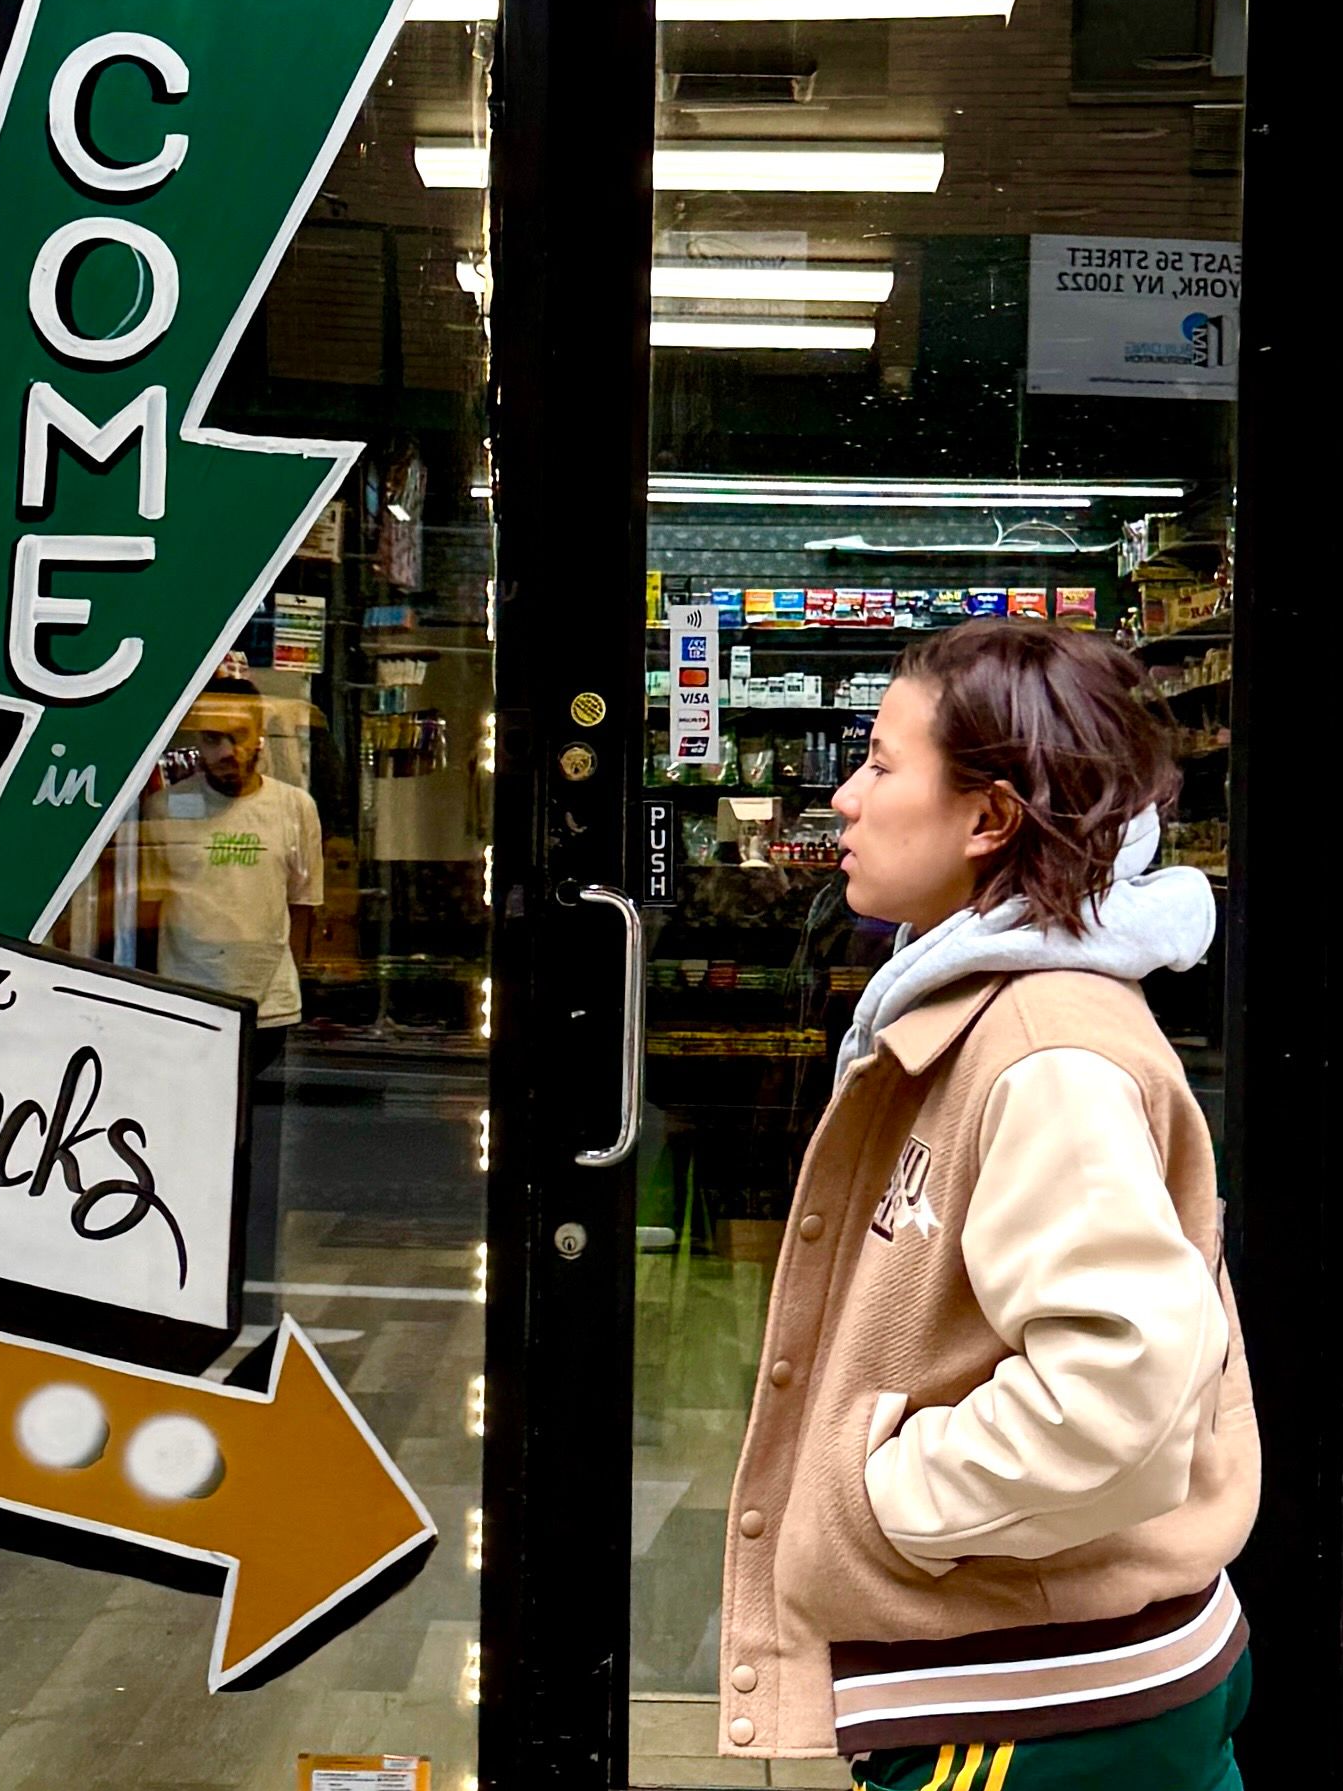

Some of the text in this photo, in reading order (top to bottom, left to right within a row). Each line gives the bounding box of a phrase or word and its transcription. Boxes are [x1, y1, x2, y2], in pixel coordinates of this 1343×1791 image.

[11, 31, 190, 699] COME
[681, 694, 709, 704] VISA
[33, 742, 102, 810] in
[651, 807, 666, 896] PUSH
